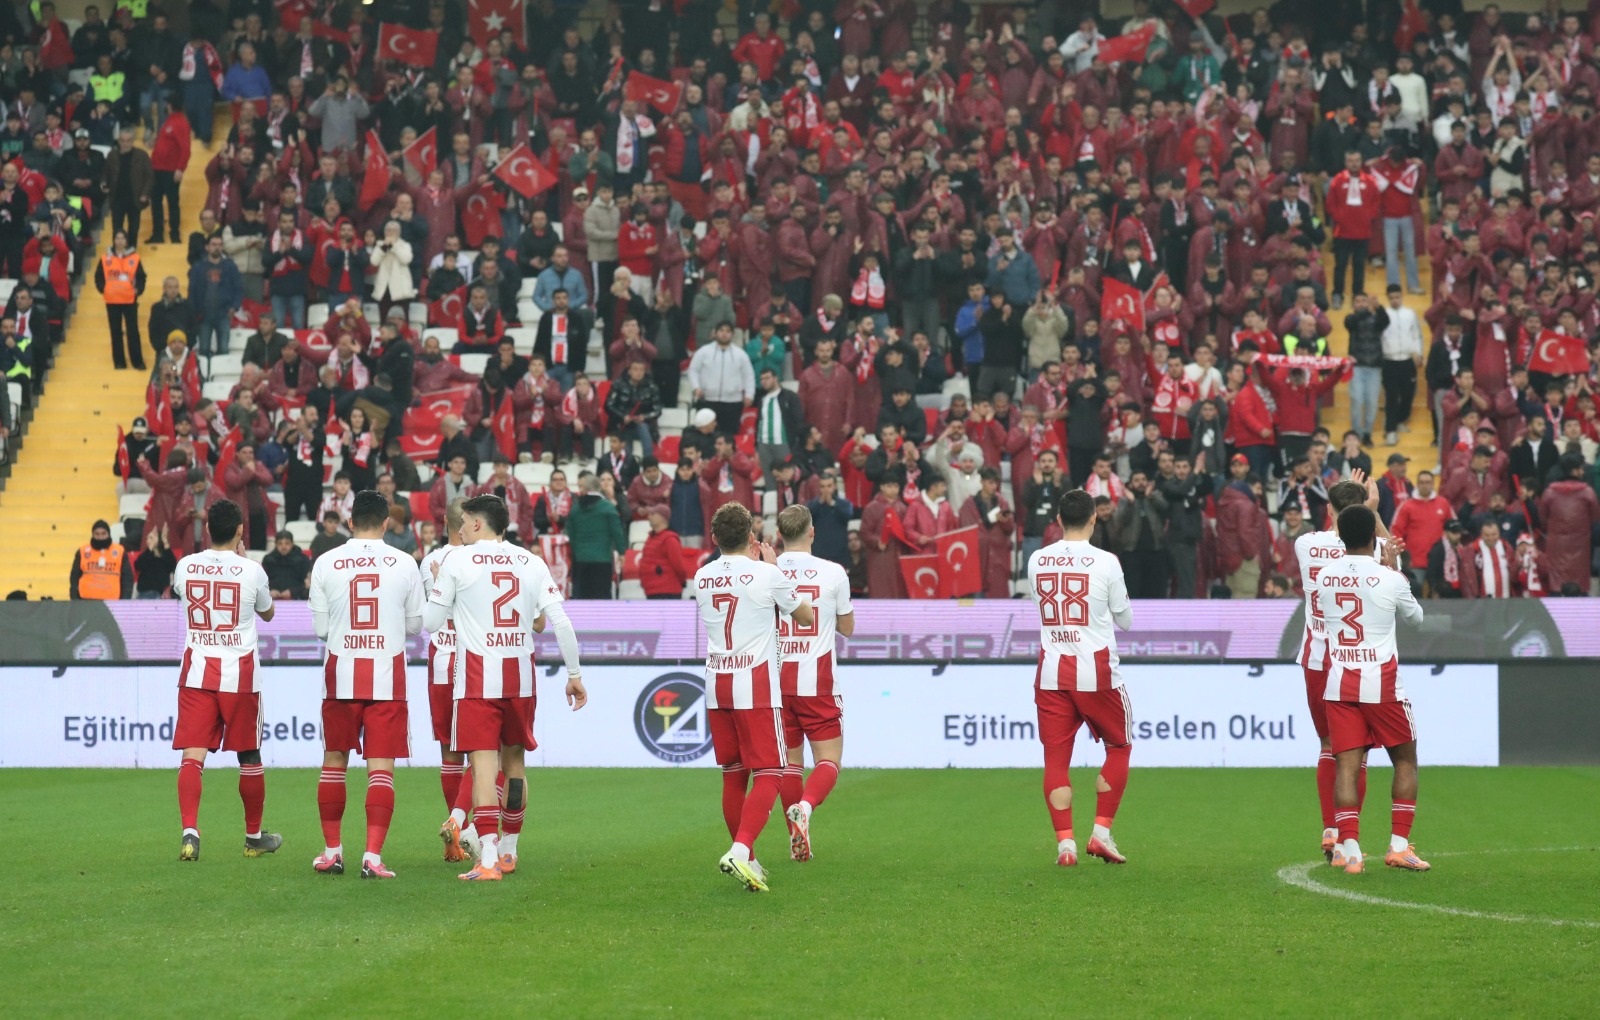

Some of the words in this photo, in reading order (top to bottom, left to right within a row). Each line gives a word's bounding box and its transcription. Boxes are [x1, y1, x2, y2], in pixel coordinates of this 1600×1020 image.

[333, 557, 377, 570] anex
[472, 554, 513, 565] anex
[1038, 556, 1074, 567] anex
[187, 563, 224, 576] anex
[782, 569, 798, 580] ex
[698, 576, 733, 590] anex
[1322, 575, 1360, 588] anex
[185, 579, 241, 632] 89
[349, 573, 380, 631] 6
[491, 571, 520, 628] 2
[1036, 572, 1090, 627] 88
[711, 592, 739, 651] 7
[1335, 592, 1365, 647] 3
[343, 635, 385, 649] SONER
[486, 632, 526, 647] SAMET
[778, 640, 811, 655] TORM
[63, 715, 173, 747] Eğitimd
[943, 714, 1036, 746] Eğitim
[1228, 713, 1296, 741] Okul
